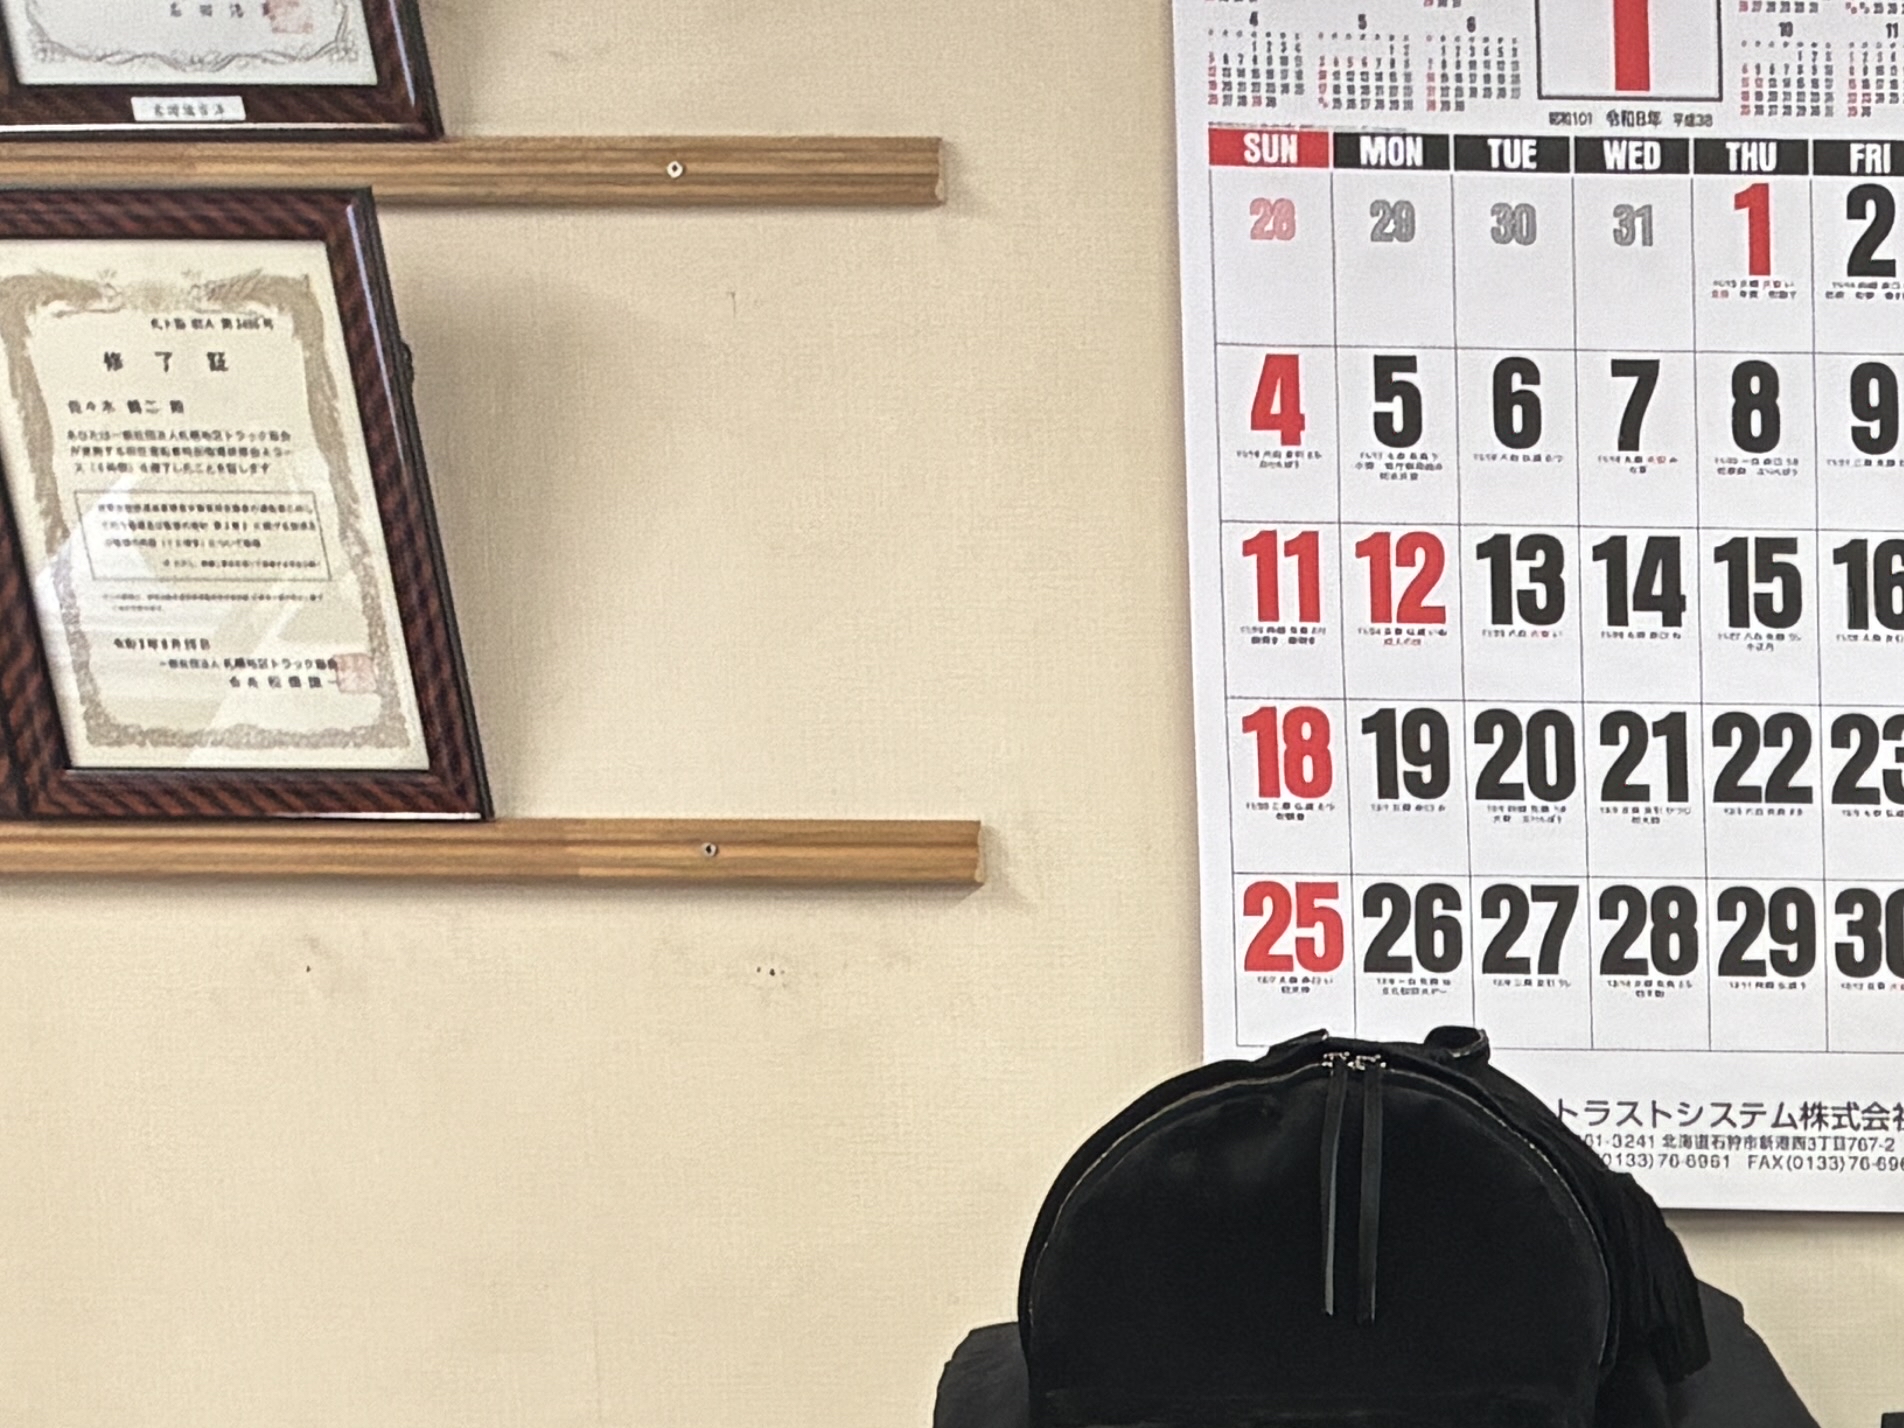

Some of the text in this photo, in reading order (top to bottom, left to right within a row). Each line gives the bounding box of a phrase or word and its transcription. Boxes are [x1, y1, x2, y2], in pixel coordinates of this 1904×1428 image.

[1243, 132, 1299, 166] SUN
[1360, 136, 1422, 166] MON
[1488, 139, 1536, 169] TUE
[1604, 140, 1660, 170] WED
[1726, 142, 1776, 171] THU
[1850, 143, 1890, 173] FRI
[1606, 110, 1661, 128] 令和8年
[1489, 200, 1537, 247] 30
[1613, 202, 1654, 248] 31
[1734, 183, 1770, 276] 1
[1847, 184, 1896, 277] 2
[1251, 354, 1305, 446] 4
[1374, 355, 1422, 448] 5
[1493, 357, 1541, 449] 6
[1611, 359, 1660, 451] 7
[1732, 360, 1780, 453] 8
[1851, 362, 1898, 455] 9
[1242, 530, 1320, 623] 11
[1355, 532, 1446, 624] 12
[1476, 534, 1565, 625] 13
[1592, 535, 1686, 627] 14
[1714, 537, 1802, 629] 15
[1242, 706, 1332, 798] 18
[1362, 708, 1450, 799] 19
[1474, 709, 1576, 802] 20
[1600, 710, 1688, 802] 21
[1712, 712, 1813, 804] 22
[1243, 881, 1344, 972] 25
[1363, 883, 1462, 973] 26
[1481, 884, 1579, 974] 27
[1599, 885, 1698, 976] 28
[1717, 886, 1816, 977] 29
